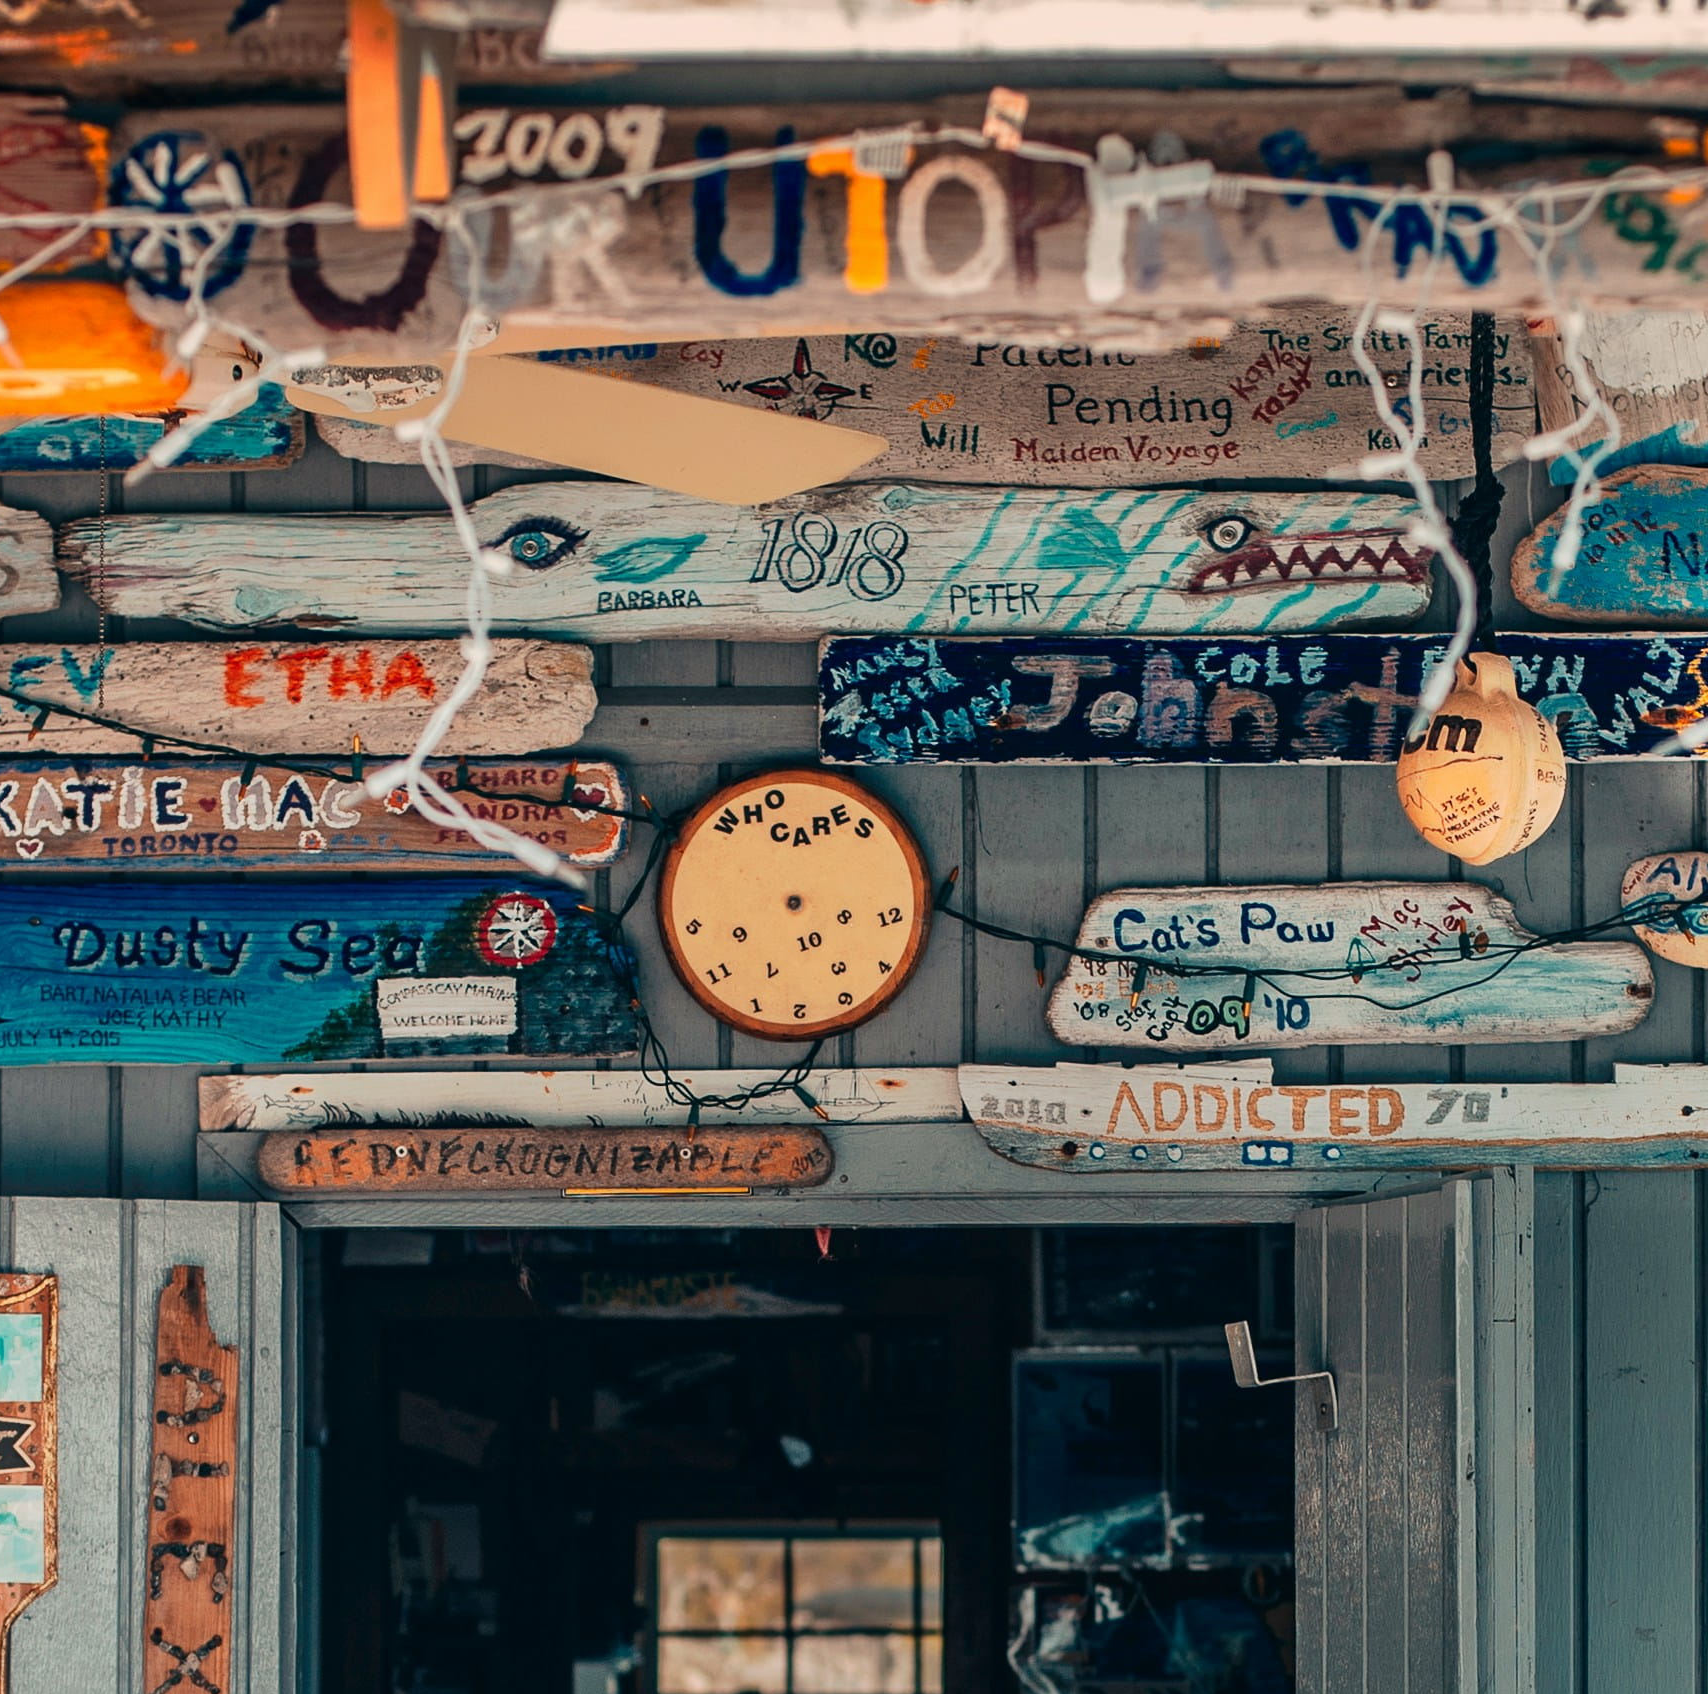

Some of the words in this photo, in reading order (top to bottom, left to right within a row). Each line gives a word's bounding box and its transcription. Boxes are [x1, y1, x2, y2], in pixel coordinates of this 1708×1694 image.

[1258, 326, 1310, 353] The
[1046, 384, 1233, 437] Pending
[920, 420, 980, 456] Will
[1011, 436, 1118, 465] Maiden
[1122, 435, 1241, 466] Voyage
[748, 511, 910, 603] 1818
[596, 588, 704, 614] BARBARA
[948, 582, 1041, 617] PETER
[712, 788, 786, 836] WHO
[769, 803, 875, 848] CARES
[102, 835, 240, 857] TORONTO
[836, 908, 853, 926] 8
[876, 906, 905, 928] 12
[1113, 907, 1223, 953] Cat's
[1240, 901, 1336, 945] Paw
[53, 916, 248, 978] Dusty
[278, 917, 427, 979] Sea
[796, 930, 823, 952] 10
[877, 959, 893, 976] 4
[192, 987, 247, 1008] BEAR
[153, 1009, 229, 1030] KATHY
[393, 1013, 465, 1028] WELCOME
[1106, 1079, 1406, 1136] ADDICTED
